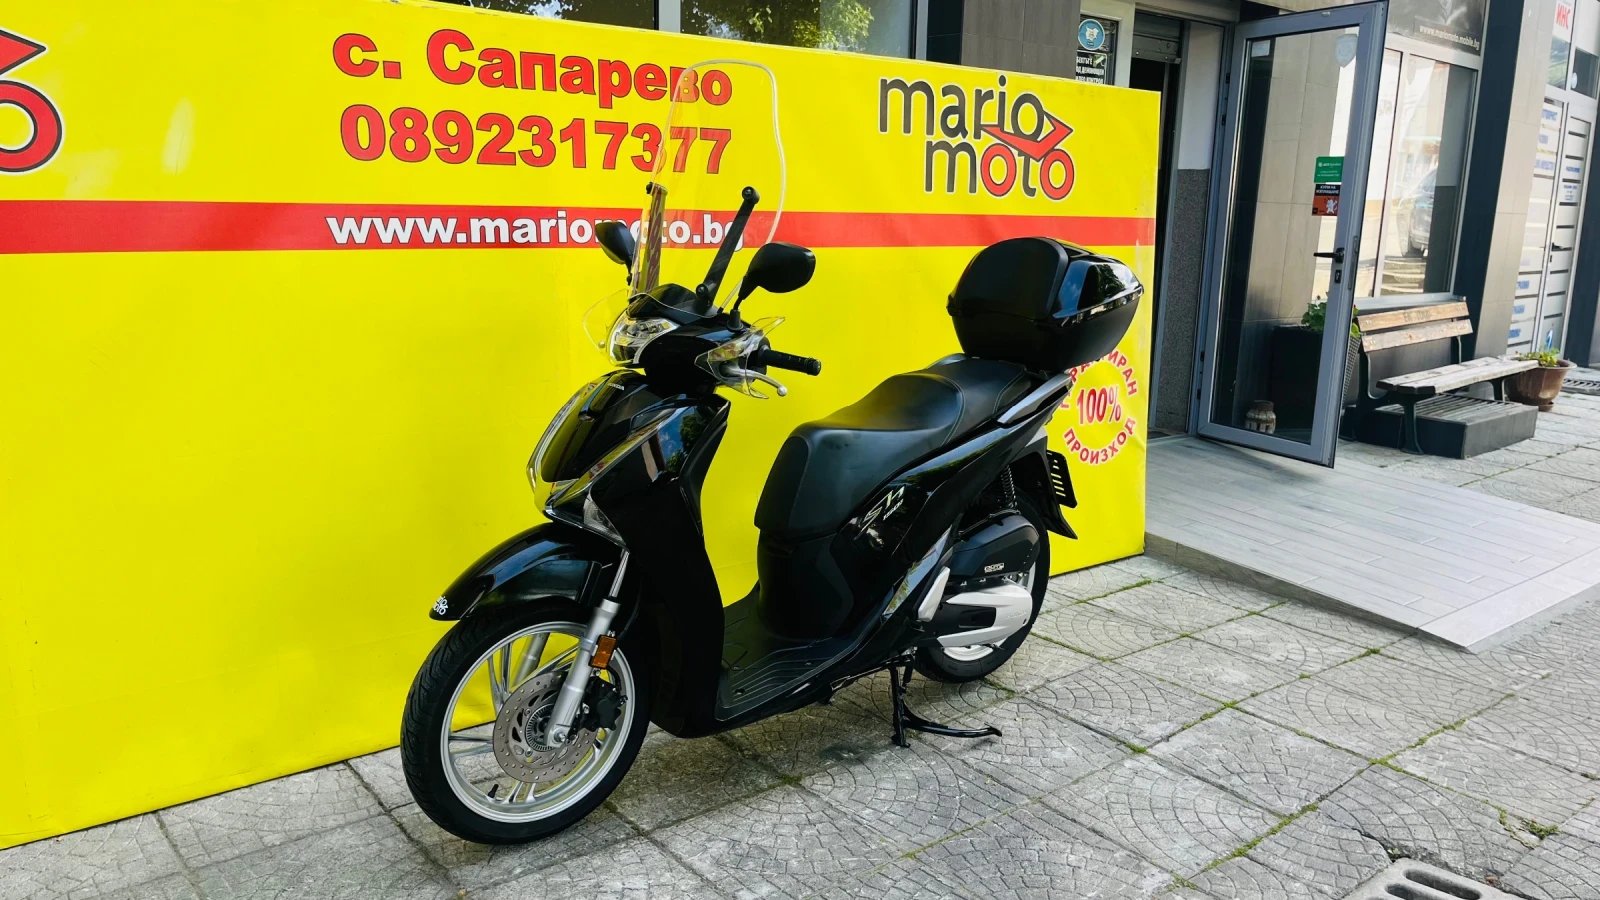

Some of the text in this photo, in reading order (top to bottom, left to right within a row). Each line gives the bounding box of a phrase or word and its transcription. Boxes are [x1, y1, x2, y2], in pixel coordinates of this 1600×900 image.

[333, 29, 733, 109] с. Сапарево
[340, 104, 732, 175] 0892317377
[878, 75, 1045, 141] mario
[924, 138, 1075, 201] moto
[325, 210, 745, 252] www.mariooo.bg
[1076, 386, 1122, 425] 100%
[1063, 417, 1137, 465] ПРОИЗХОД
